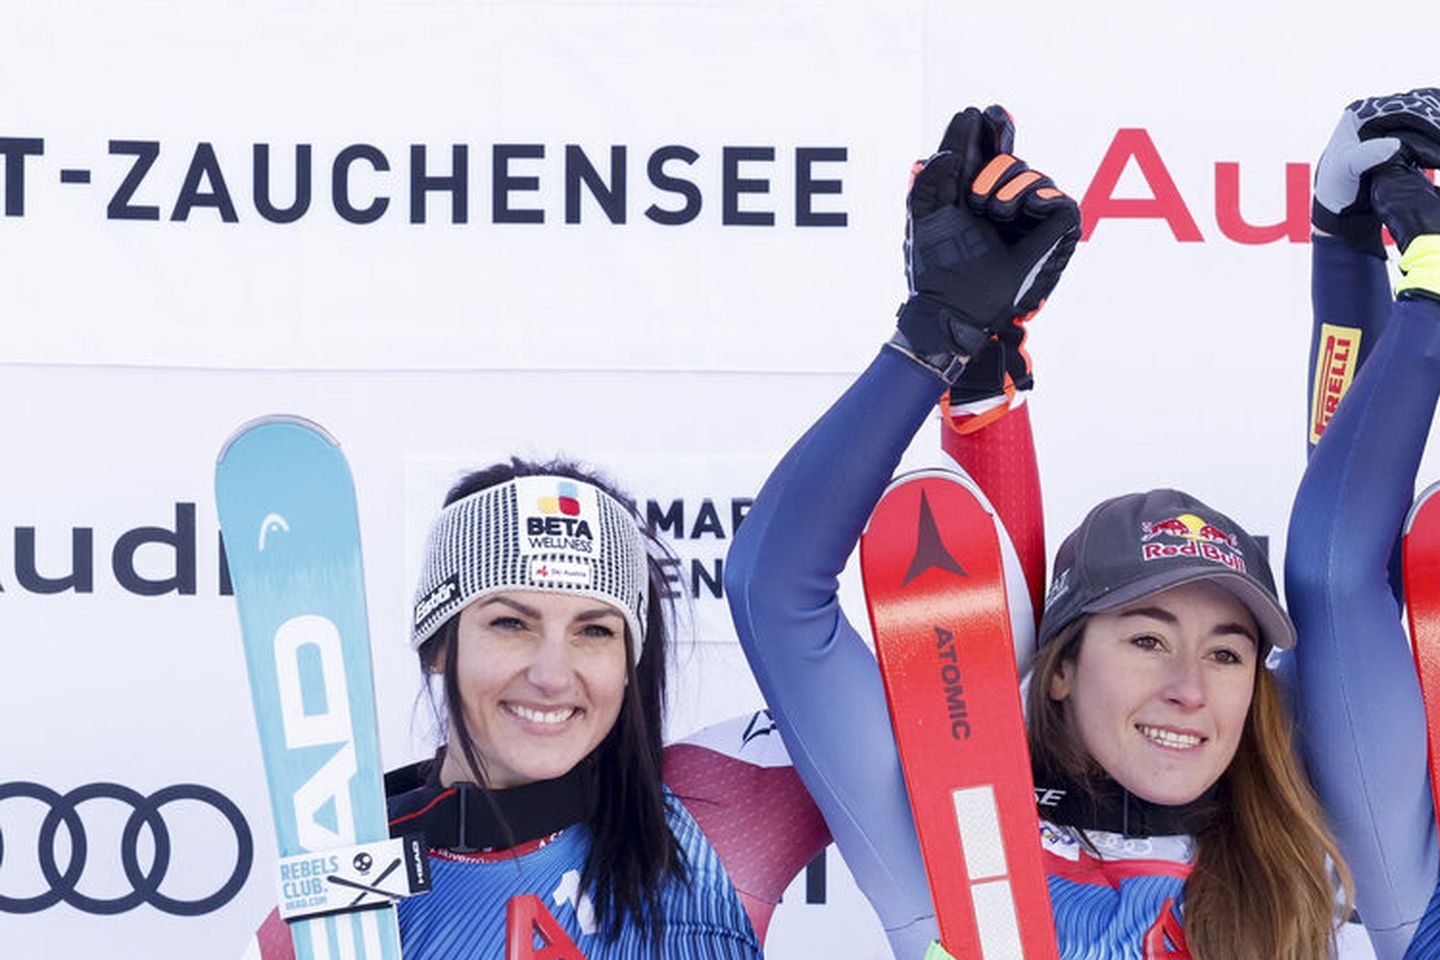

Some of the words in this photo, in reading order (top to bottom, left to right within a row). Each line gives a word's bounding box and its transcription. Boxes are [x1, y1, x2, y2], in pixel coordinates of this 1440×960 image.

[1080, 128, 1420, 244] Au
[526, 516, 594, 541] BETA
[0, 501, 234, 597] ud
[527, 537, 593, 554] WELLNESS
[1144, 541, 1199, 561] Red
[1200, 543, 1247, 573] Bull
[934, 625, 972, 741] ATOMIC
[280, 857, 339, 881] REBELS
[283, 877, 328, 899] CLUB.
